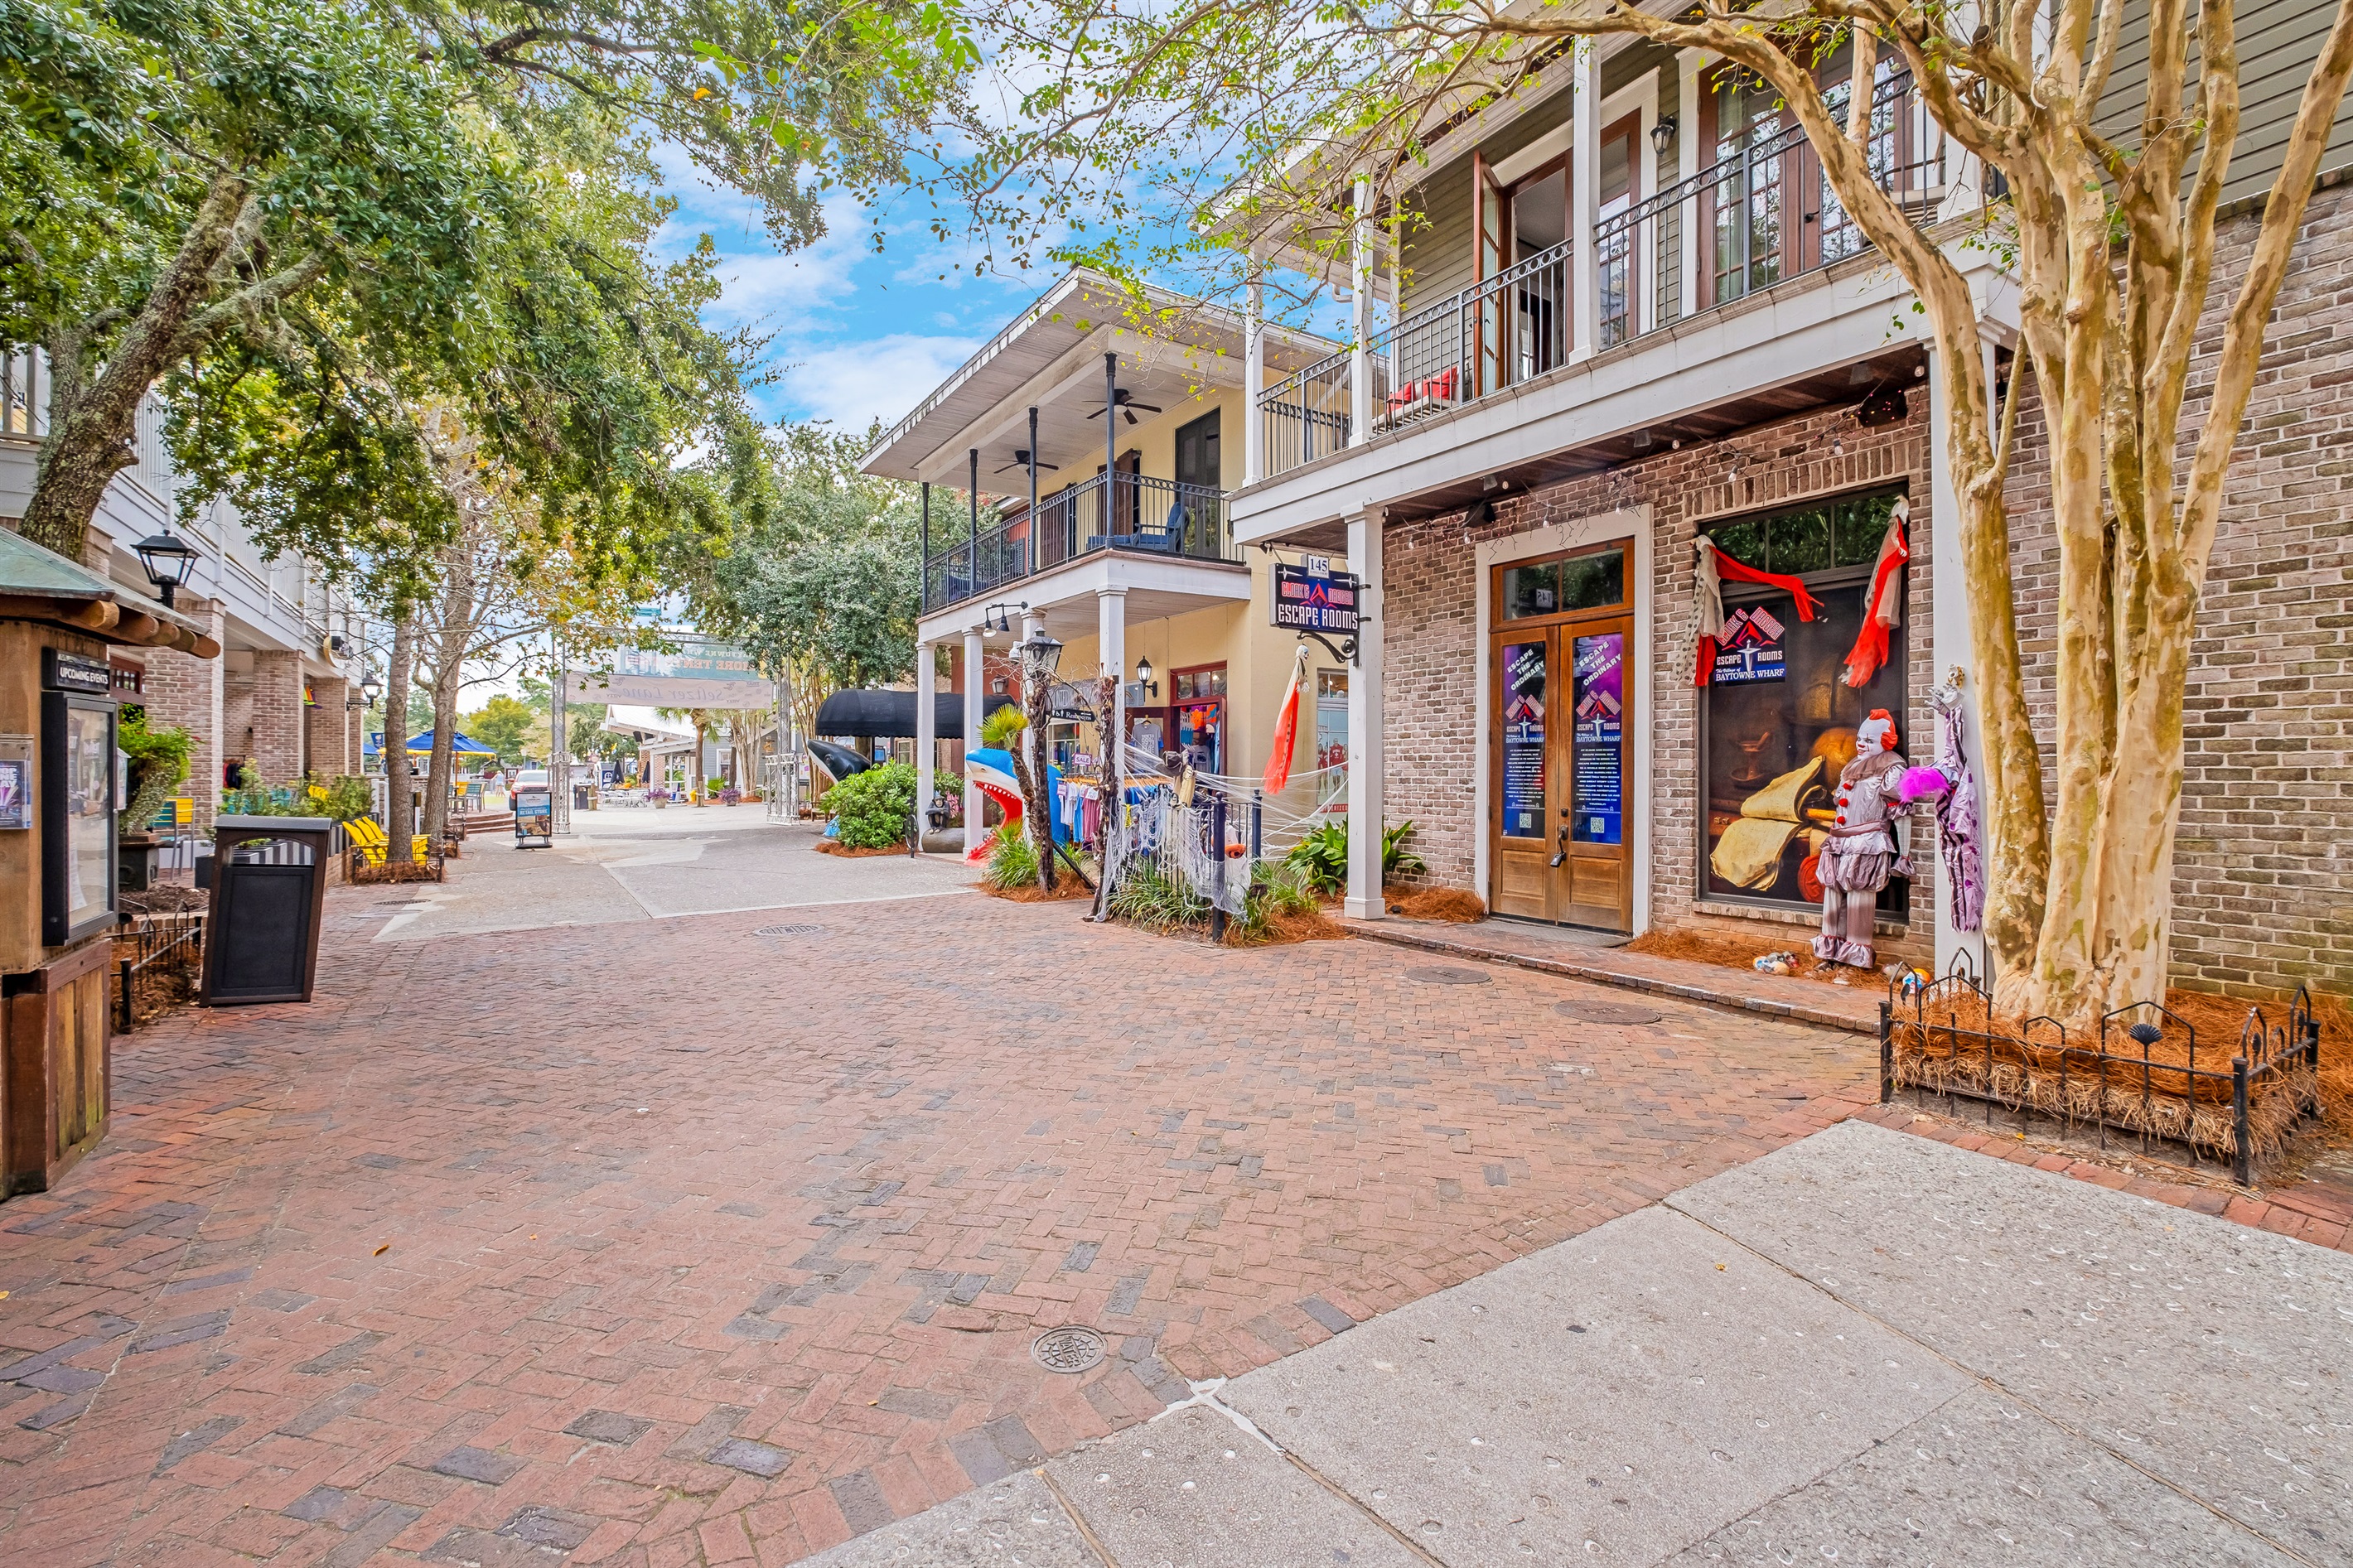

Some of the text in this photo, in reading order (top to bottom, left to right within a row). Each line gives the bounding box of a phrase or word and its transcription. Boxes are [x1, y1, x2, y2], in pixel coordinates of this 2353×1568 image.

[1310, 558, 1328, 572] 145
[1281, 581, 1304, 598] CLOAK
[1328, 588, 1353, 605] DAGGER
[1278, 604, 1358, 629] ESCAPE ROOMS
[1749, 606, 1785, 640] DAGGER
[1507, 649, 1534, 673] ESCAPE
[1579, 641, 1609, 667] ESCAPE
[1591, 655, 1606, 669] THE
[1717, 650, 1783, 665] ESCAPE ROOMS
[60, 667, 108, 684] UPCOMING EVENTS
[1511, 661, 1544, 690] ORDINARY
[1517, 661, 1531, 675] THE
[1583, 654, 1621, 686] ORDINARY
[1715, 668, 1785, 681] BAYTOWNE WHARF
[1059, 1335, 1082, 1368] WATER
